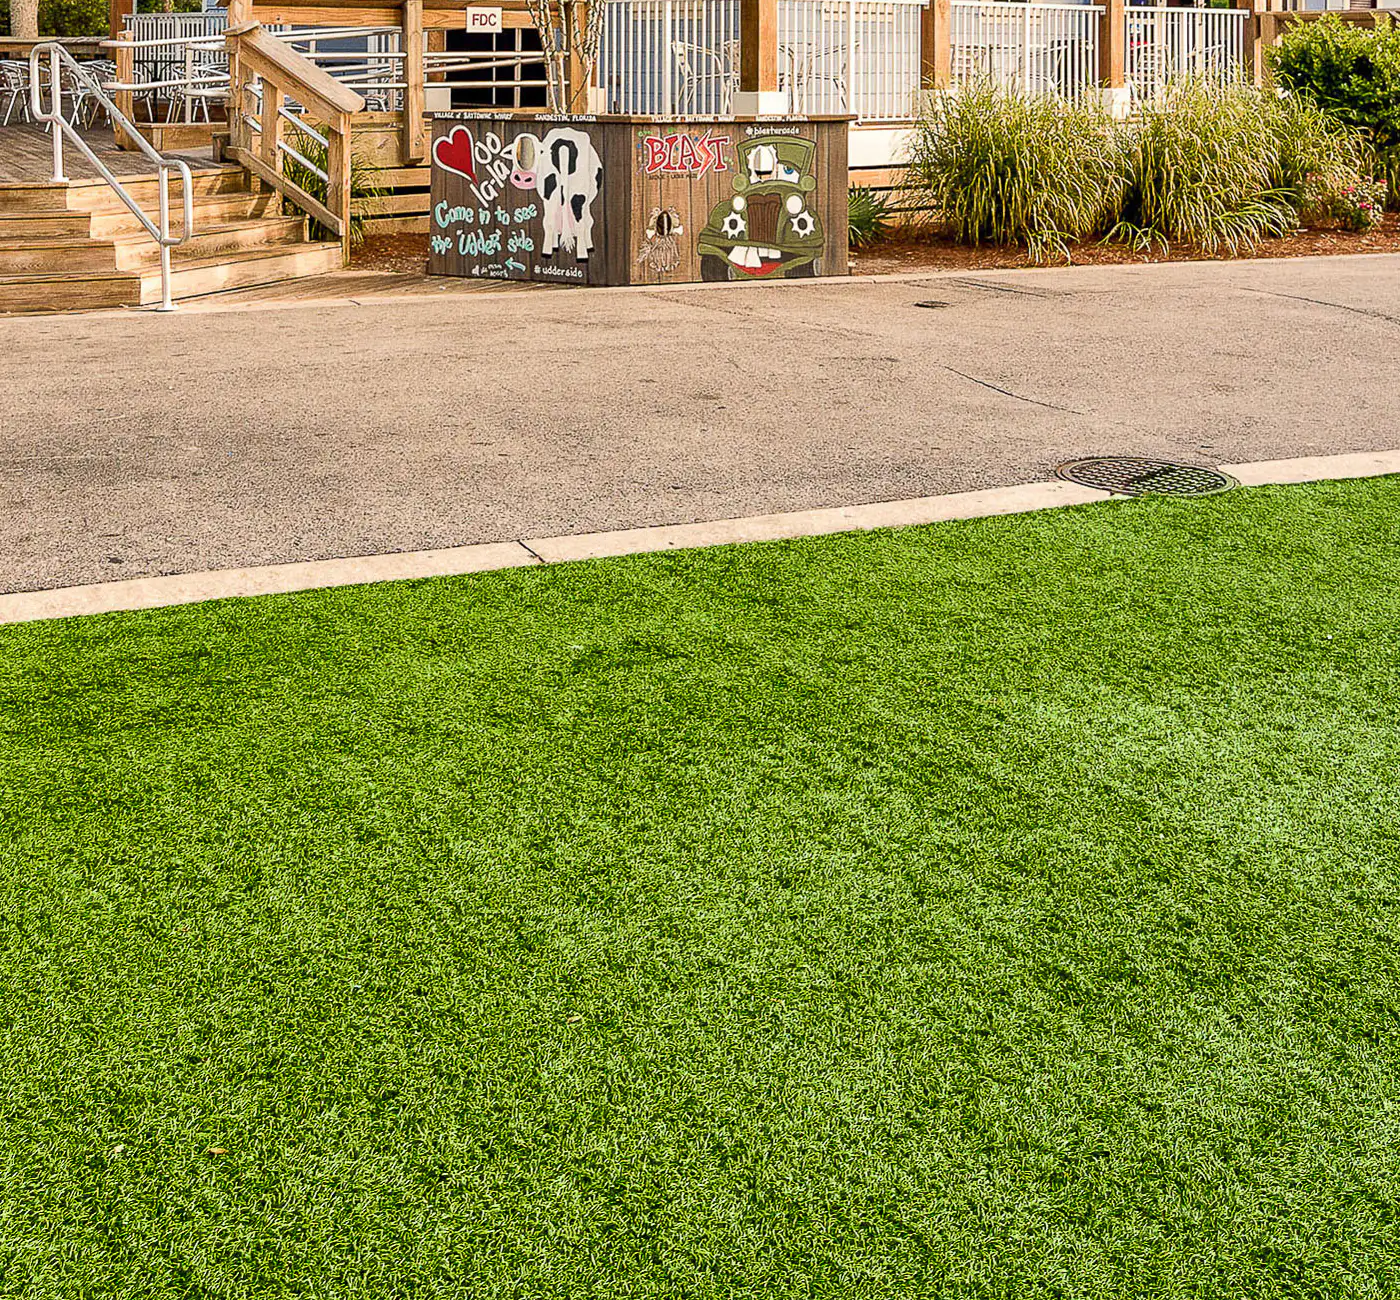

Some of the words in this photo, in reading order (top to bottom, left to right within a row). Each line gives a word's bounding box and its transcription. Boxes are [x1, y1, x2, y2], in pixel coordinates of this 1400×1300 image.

[472, 13, 497, 26] FDC
[644, 128, 730, 181] BLAST
[434, 199, 474, 228] Come
[478, 207, 491, 225] in
[494, 205, 510, 226] to
[513, 203, 538, 223] see
[431, 234, 453, 255] the
[507, 228, 535, 253] side
[534, 264, 583, 278] #udderside
